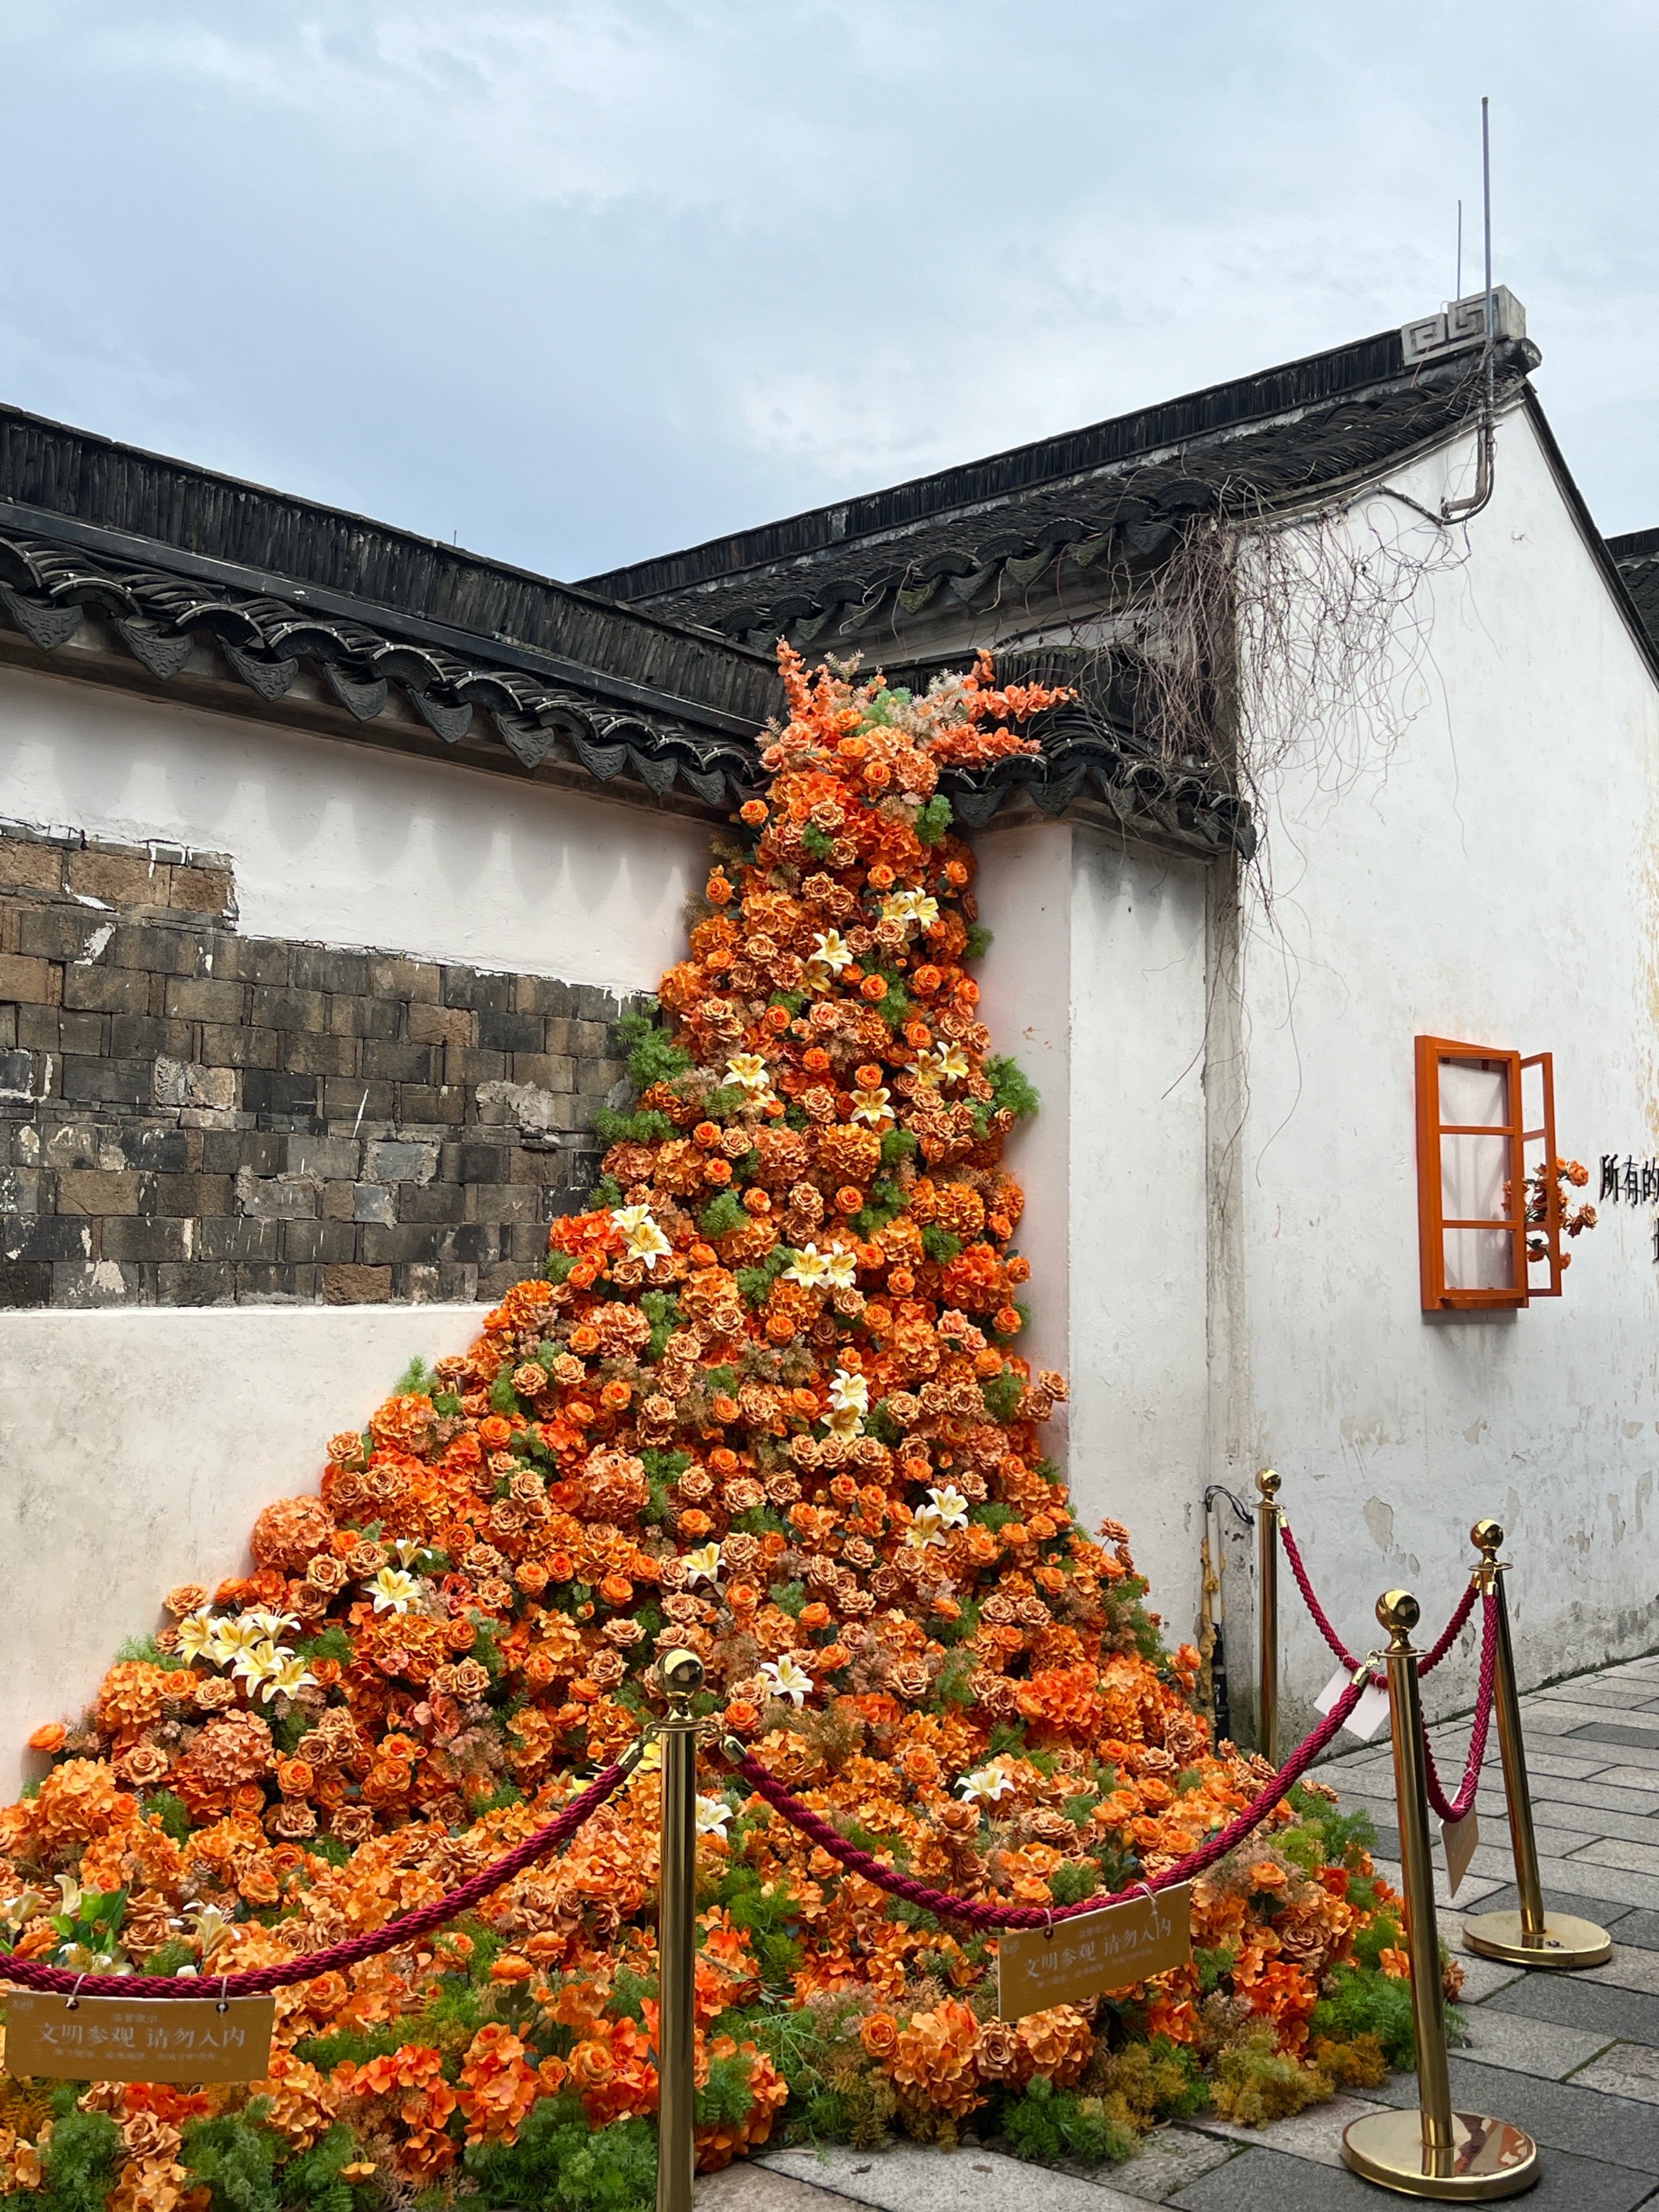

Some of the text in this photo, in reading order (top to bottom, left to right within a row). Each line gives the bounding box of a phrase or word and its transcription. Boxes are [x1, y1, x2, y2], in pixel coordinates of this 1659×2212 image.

[1600, 1154, 1659, 1206] 所有的
[1026, 1941, 1096, 1979] 文明参观
[1103, 1918, 1172, 1957] 请勿入内
[38, 2022, 246, 2049] 文明参观 请勿入内
